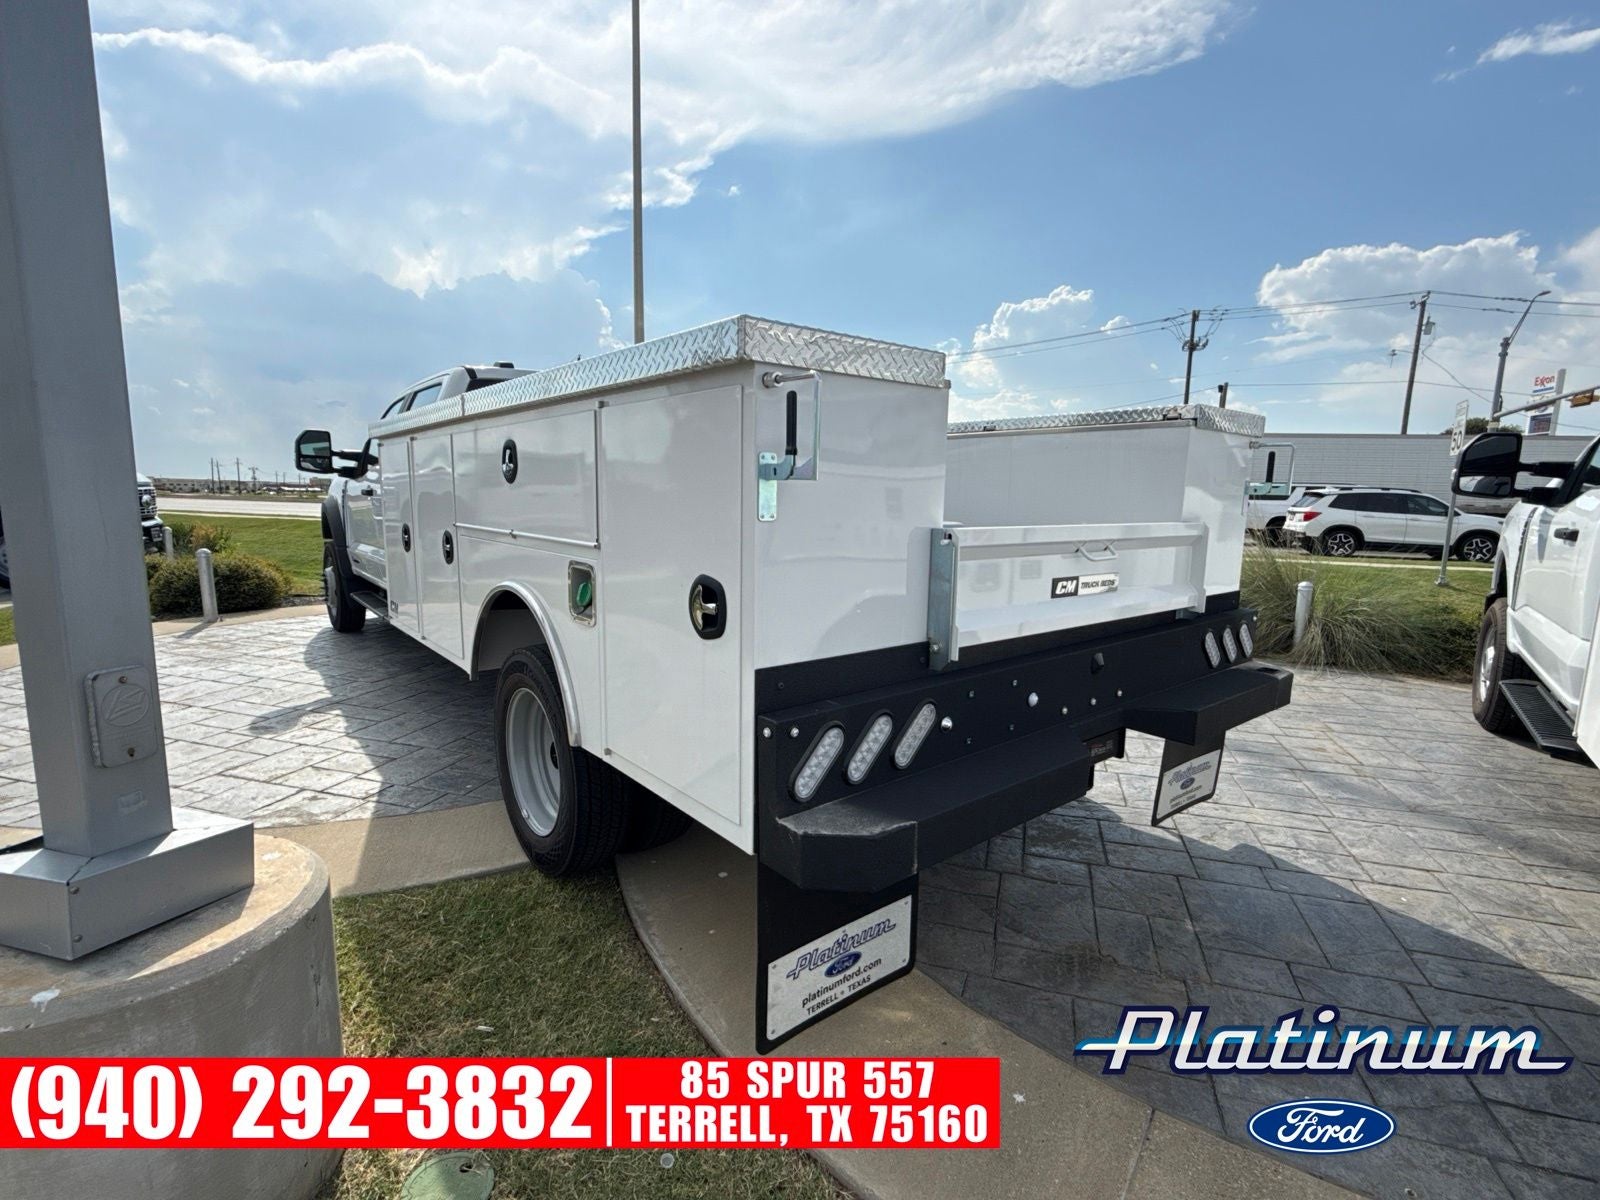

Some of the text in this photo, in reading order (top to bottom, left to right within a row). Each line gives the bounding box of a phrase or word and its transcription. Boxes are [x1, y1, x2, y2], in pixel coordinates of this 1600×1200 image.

[1055, 579, 1077, 595] CM
[1080, 580, 1099, 589] TRUCK
[785, 918, 897, 980] Platinum
[830, 954, 858, 975] Ford
[801, 957, 882, 1008] platinumford.com
[806, 974, 871, 1015] TERRELL TEXAS
